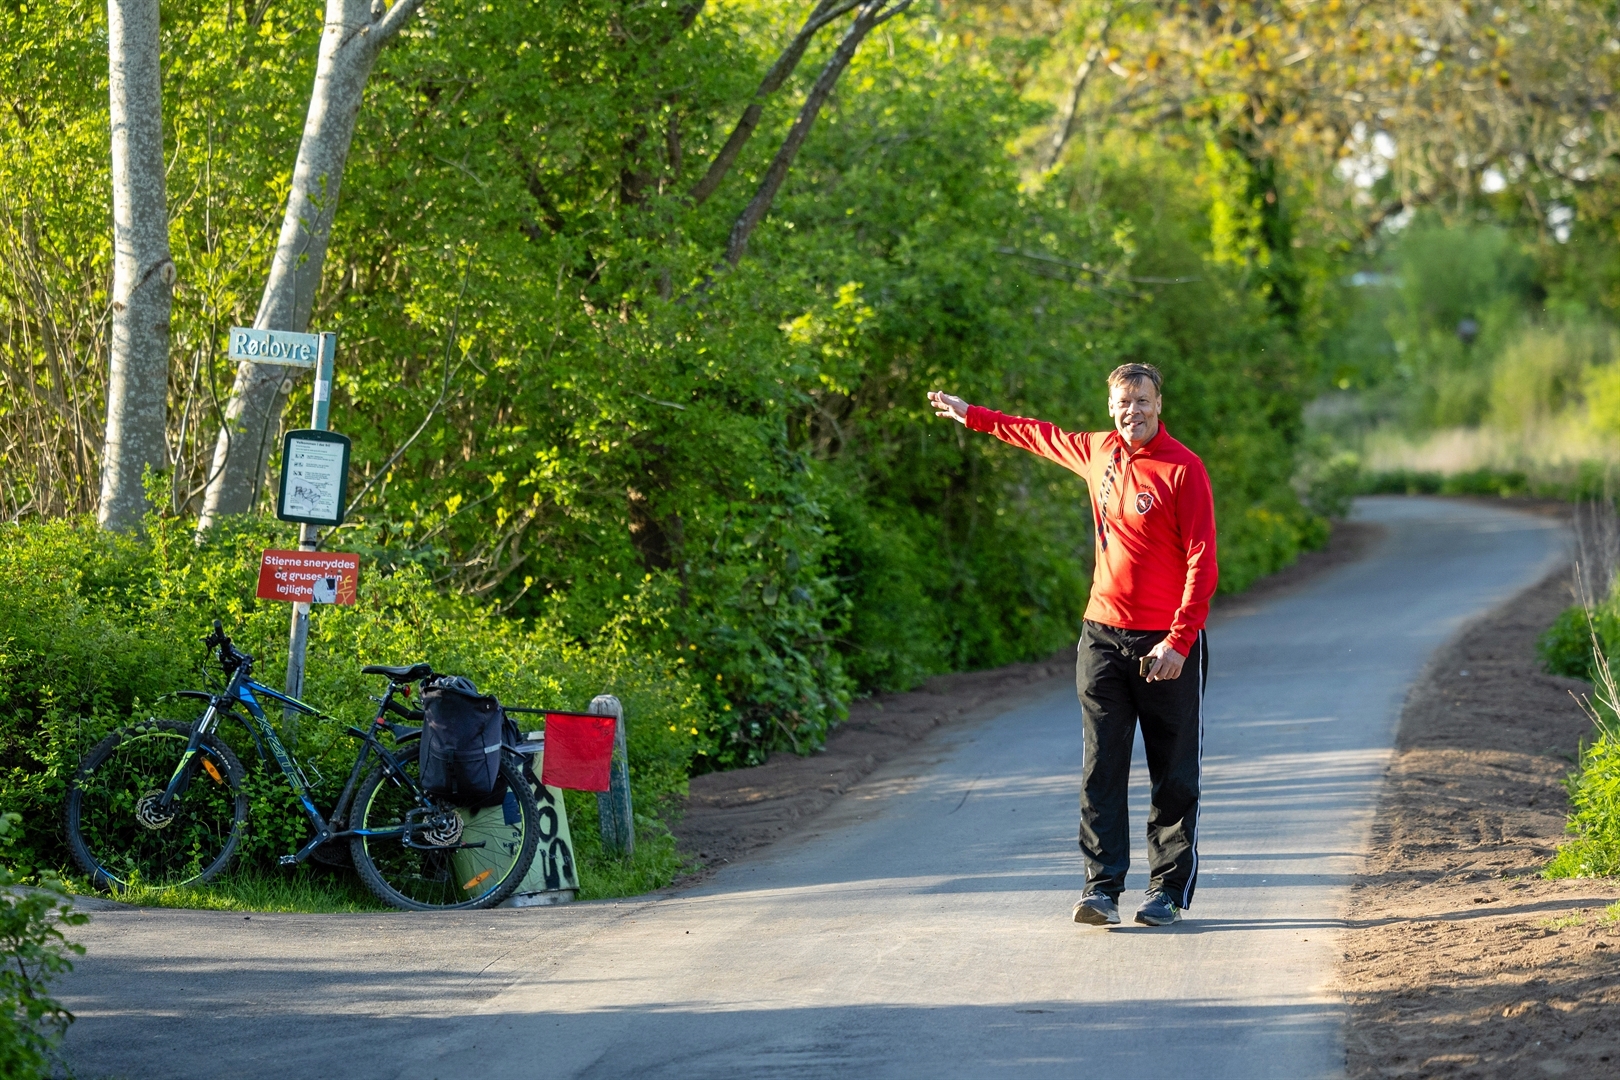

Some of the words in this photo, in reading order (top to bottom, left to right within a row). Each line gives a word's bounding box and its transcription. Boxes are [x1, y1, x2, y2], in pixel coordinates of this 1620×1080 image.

[235, 332, 311, 361] Rødovre
[264, 556, 302, 566] Stierne
[303, 559, 355, 570] sneryddes
[274, 571, 287, 582] og
[288, 572, 322, 582] gruses
[276, 584, 313, 596] lejlighe
